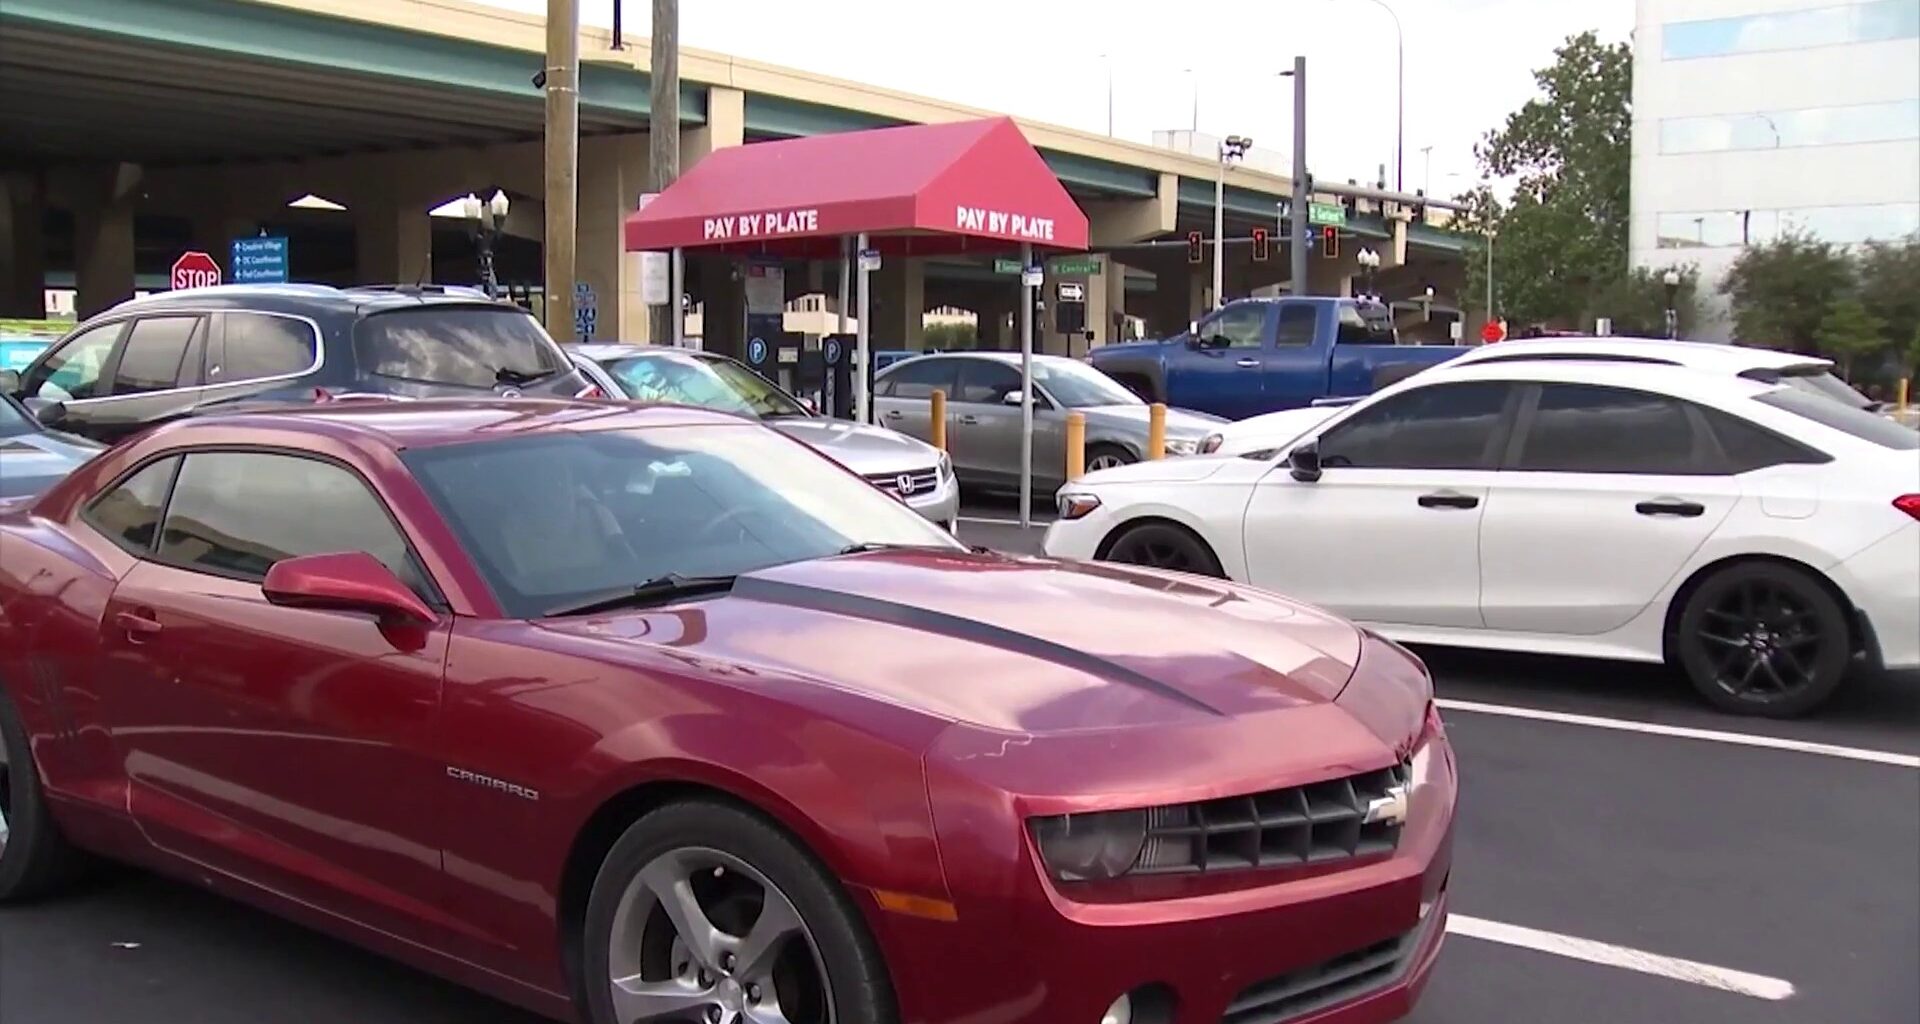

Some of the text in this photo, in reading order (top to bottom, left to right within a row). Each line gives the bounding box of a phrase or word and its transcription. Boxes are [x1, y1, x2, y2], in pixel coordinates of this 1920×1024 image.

[704, 209, 818, 240] PAY BY PLATE
[957, 205, 1054, 240] PAY BY PLATE
[176, 268, 218, 289] STOP
[446, 765, 539, 801] CAMARO
